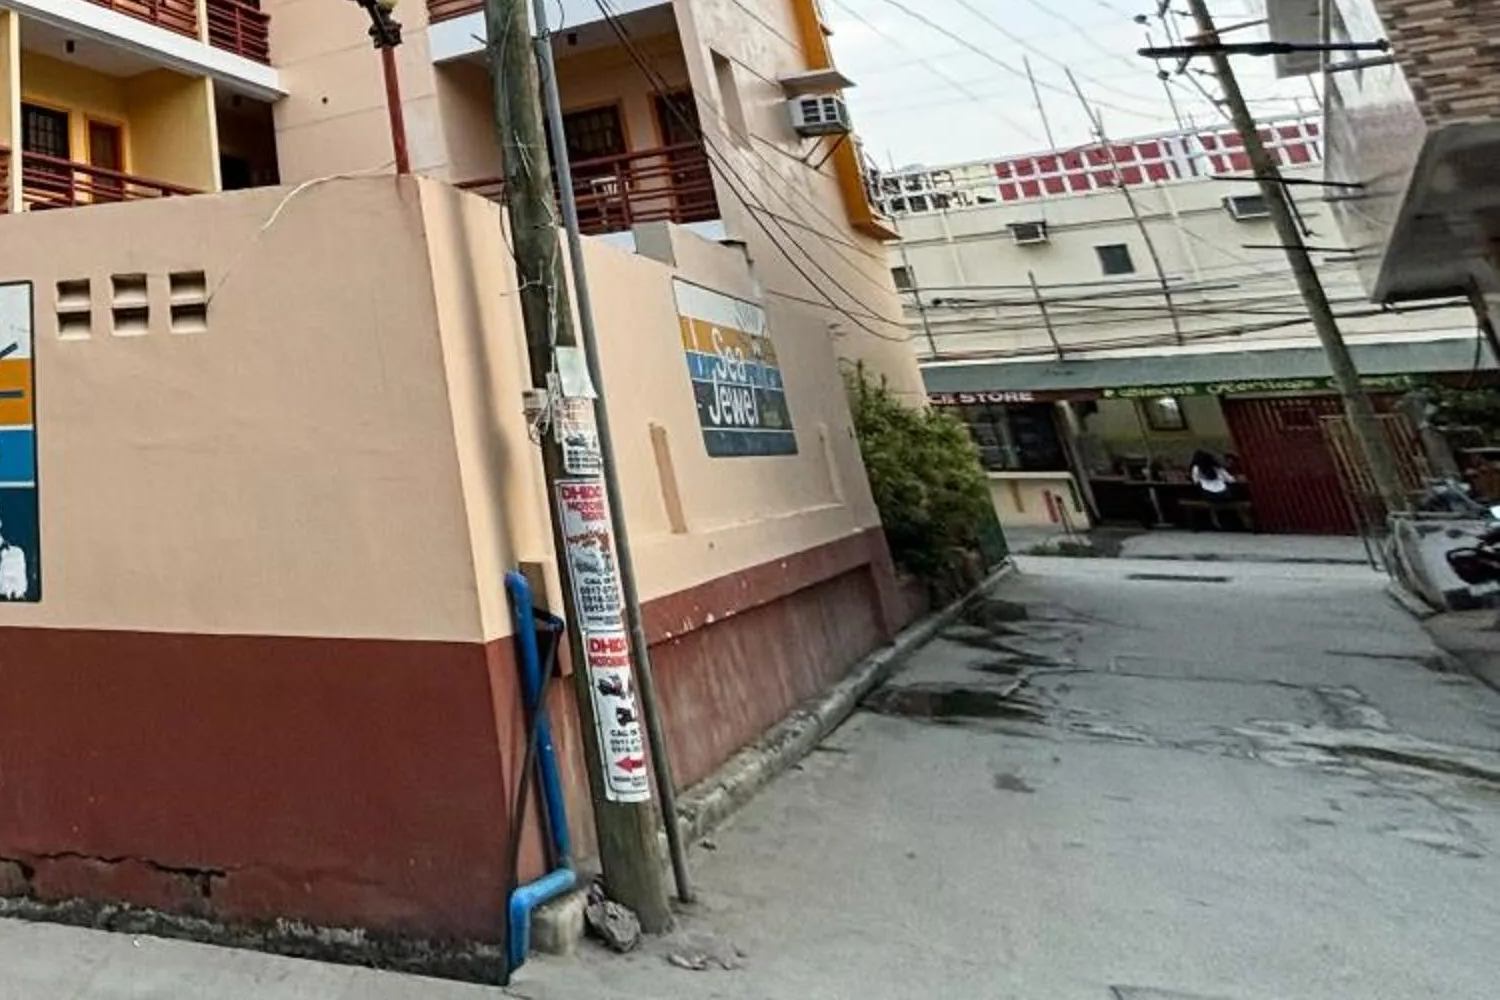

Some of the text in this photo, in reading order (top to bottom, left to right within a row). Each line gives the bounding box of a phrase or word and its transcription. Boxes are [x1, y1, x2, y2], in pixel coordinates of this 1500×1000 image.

[710, 327, 747, 382] Sea
[708, 370, 760, 426] Jewel
[959, 391, 1036, 404] STORE
